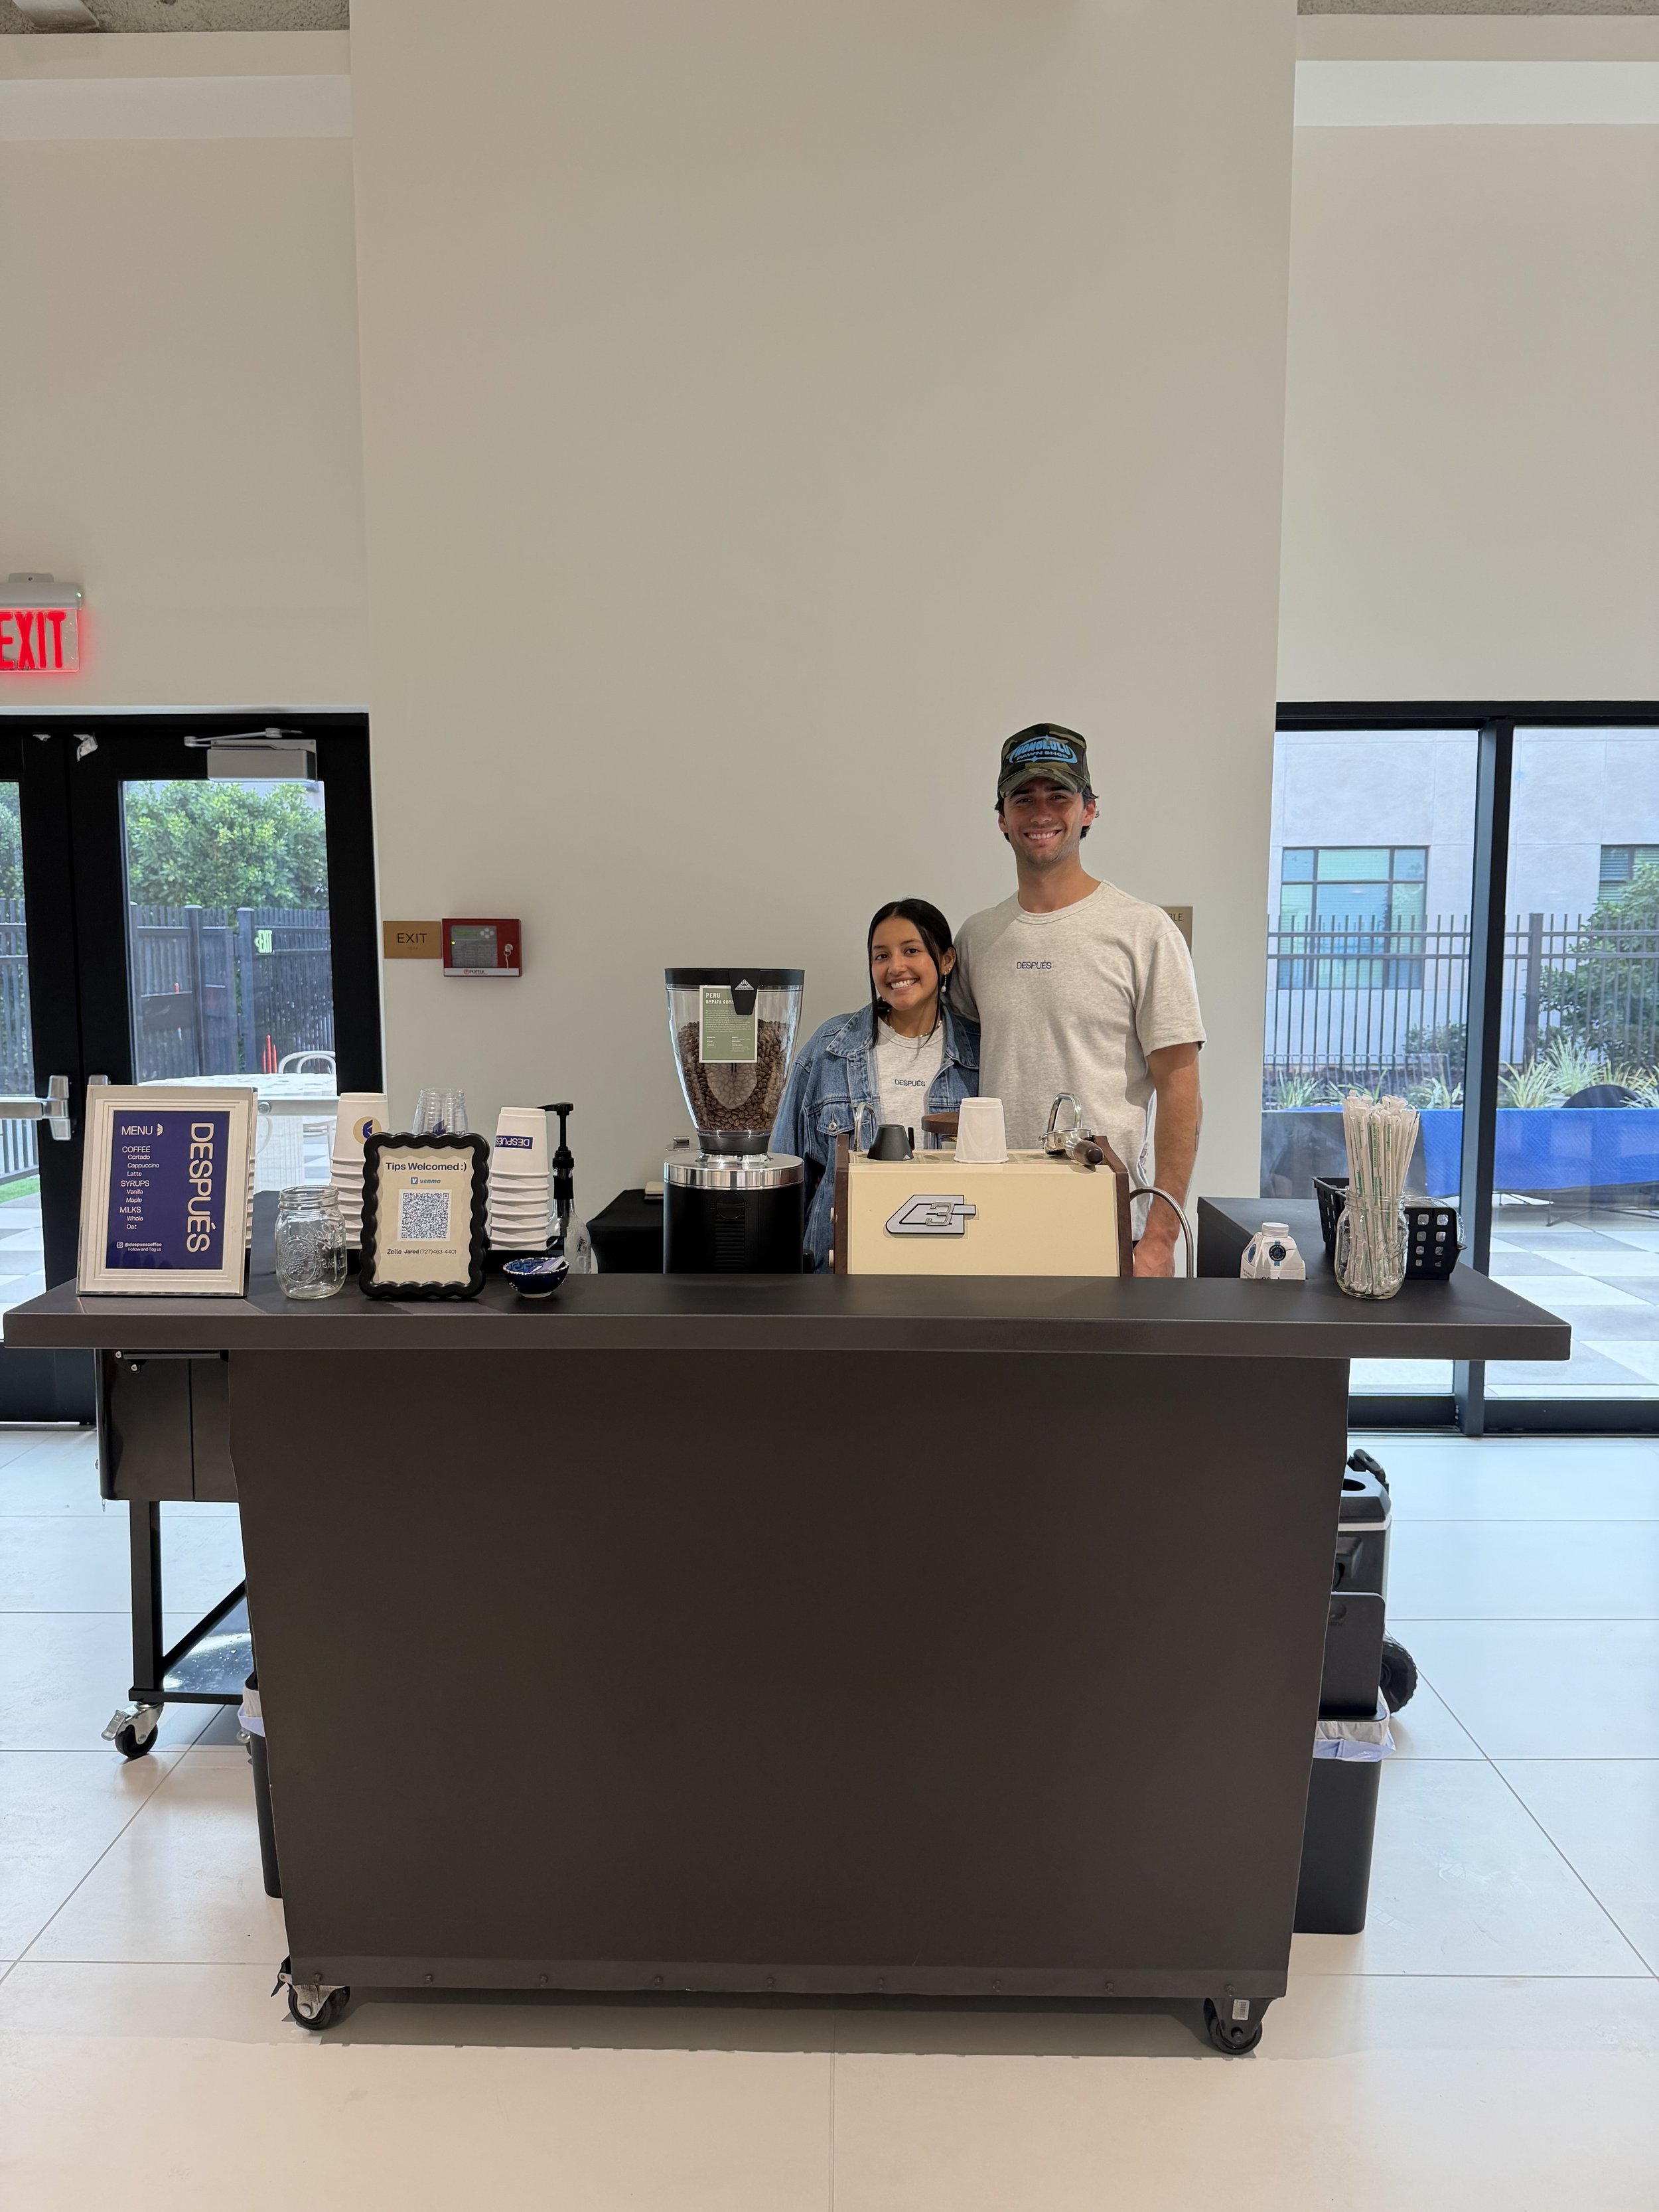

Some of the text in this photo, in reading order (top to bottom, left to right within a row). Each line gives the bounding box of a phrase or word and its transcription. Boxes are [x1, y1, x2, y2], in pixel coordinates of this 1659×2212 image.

[0, 611, 67, 670] EXIT
[1014, 739, 1071, 758] HONOLULU
[1016, 751, 1043, 761] PAWN
[257, 929, 273, 954] EXIT
[397, 932, 427, 944] EXIT
[1016, 960, 1052, 969] DESPUÉS
[895, 1078, 926, 1087] DESPUÉS
[121, 1125, 153, 1136] MENU
[496, 1137, 530, 1147] DESPUÉS
[386, 1162, 406, 1171] Tips
[407, 1162, 459, 1171] Welcomed
[186, 1123, 216, 1252] DESPUÉS
